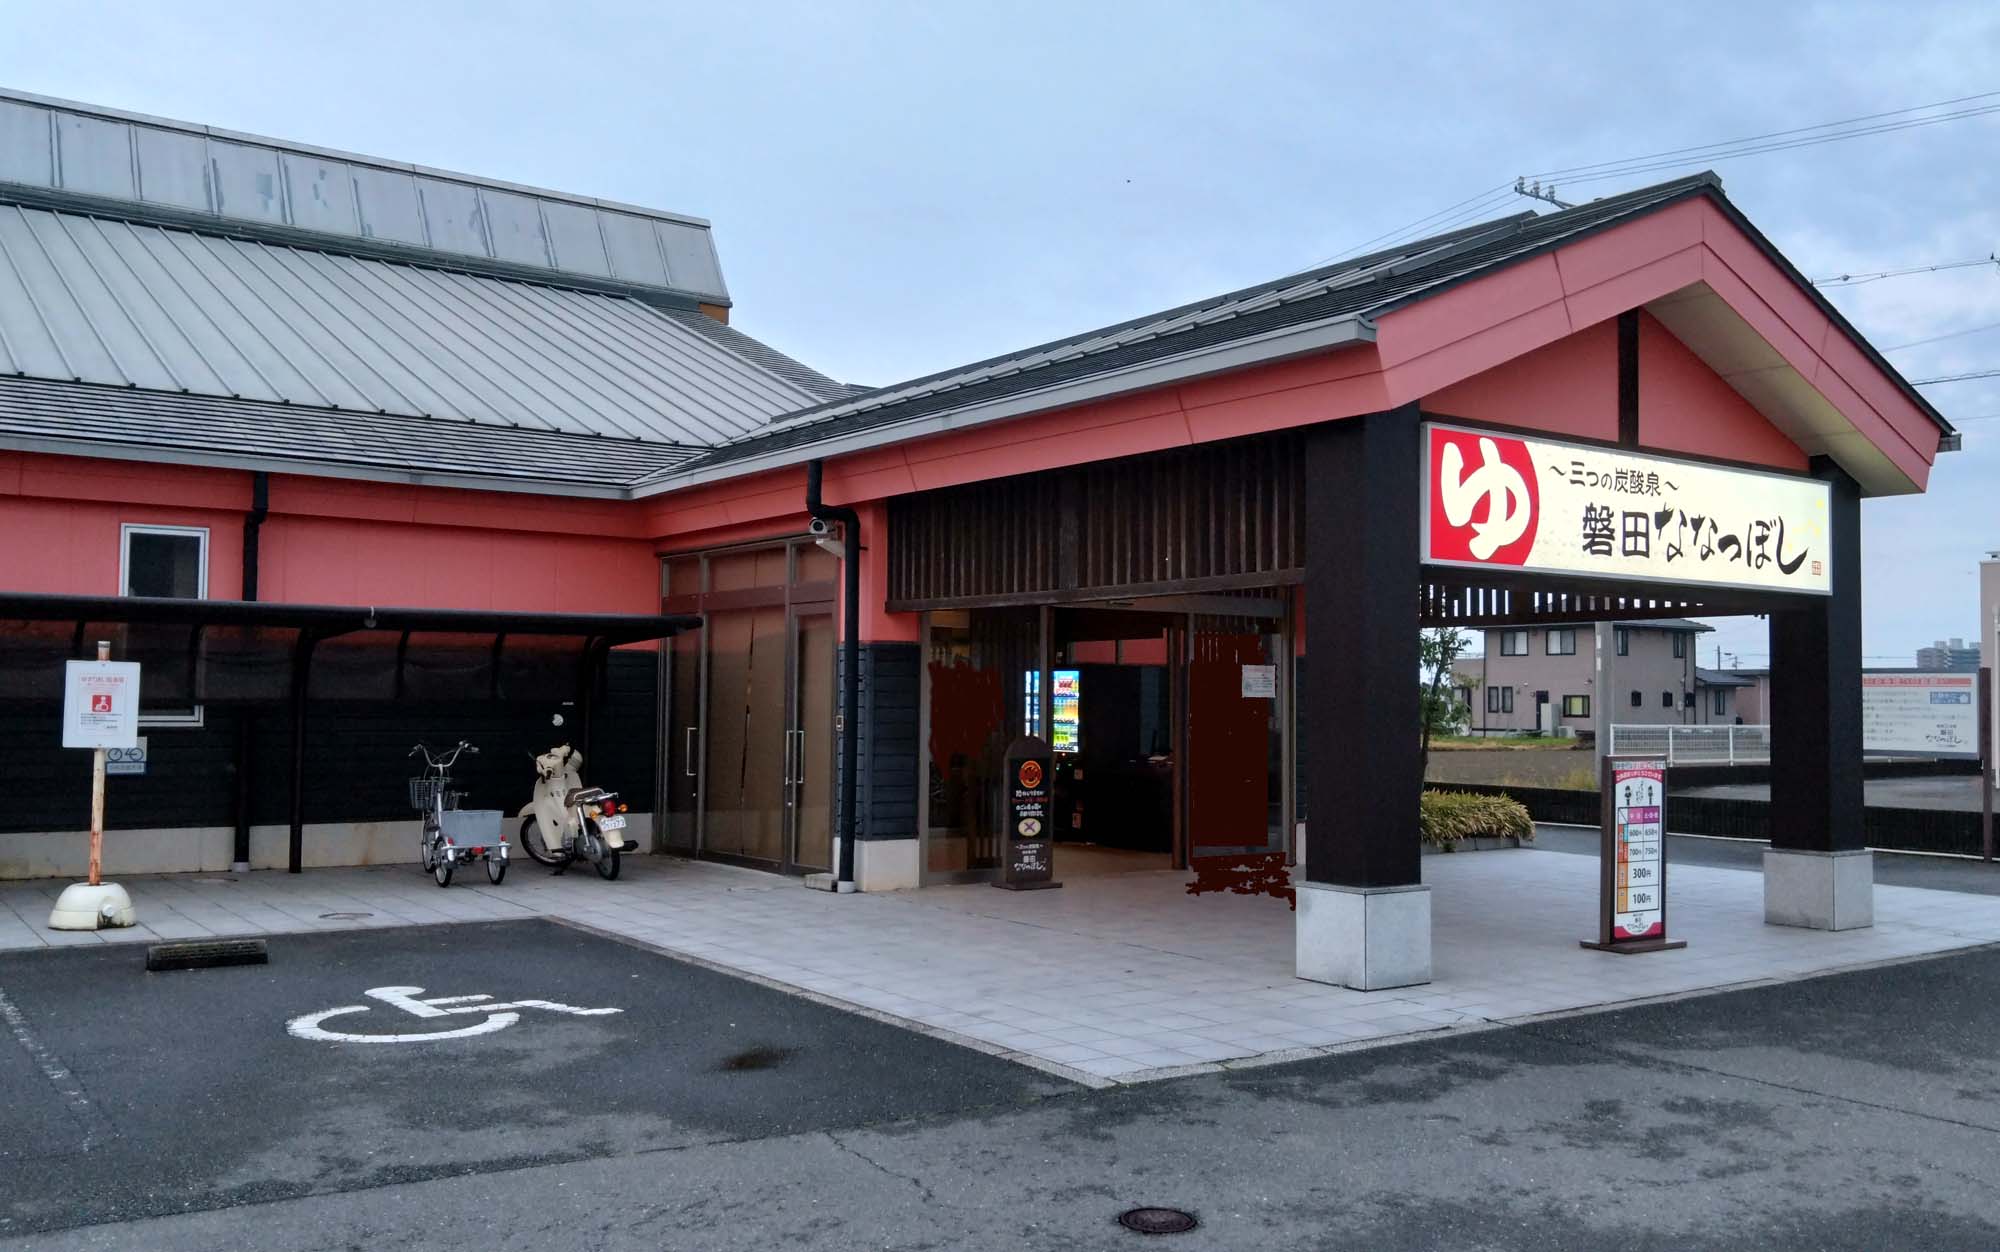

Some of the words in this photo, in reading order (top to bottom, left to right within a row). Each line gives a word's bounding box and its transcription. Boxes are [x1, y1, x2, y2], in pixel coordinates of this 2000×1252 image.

[1441, 437, 1531, 560] ゆ
[1632, 868, 1652, 879] 300円
[1632, 893, 1652, 904] 100円
